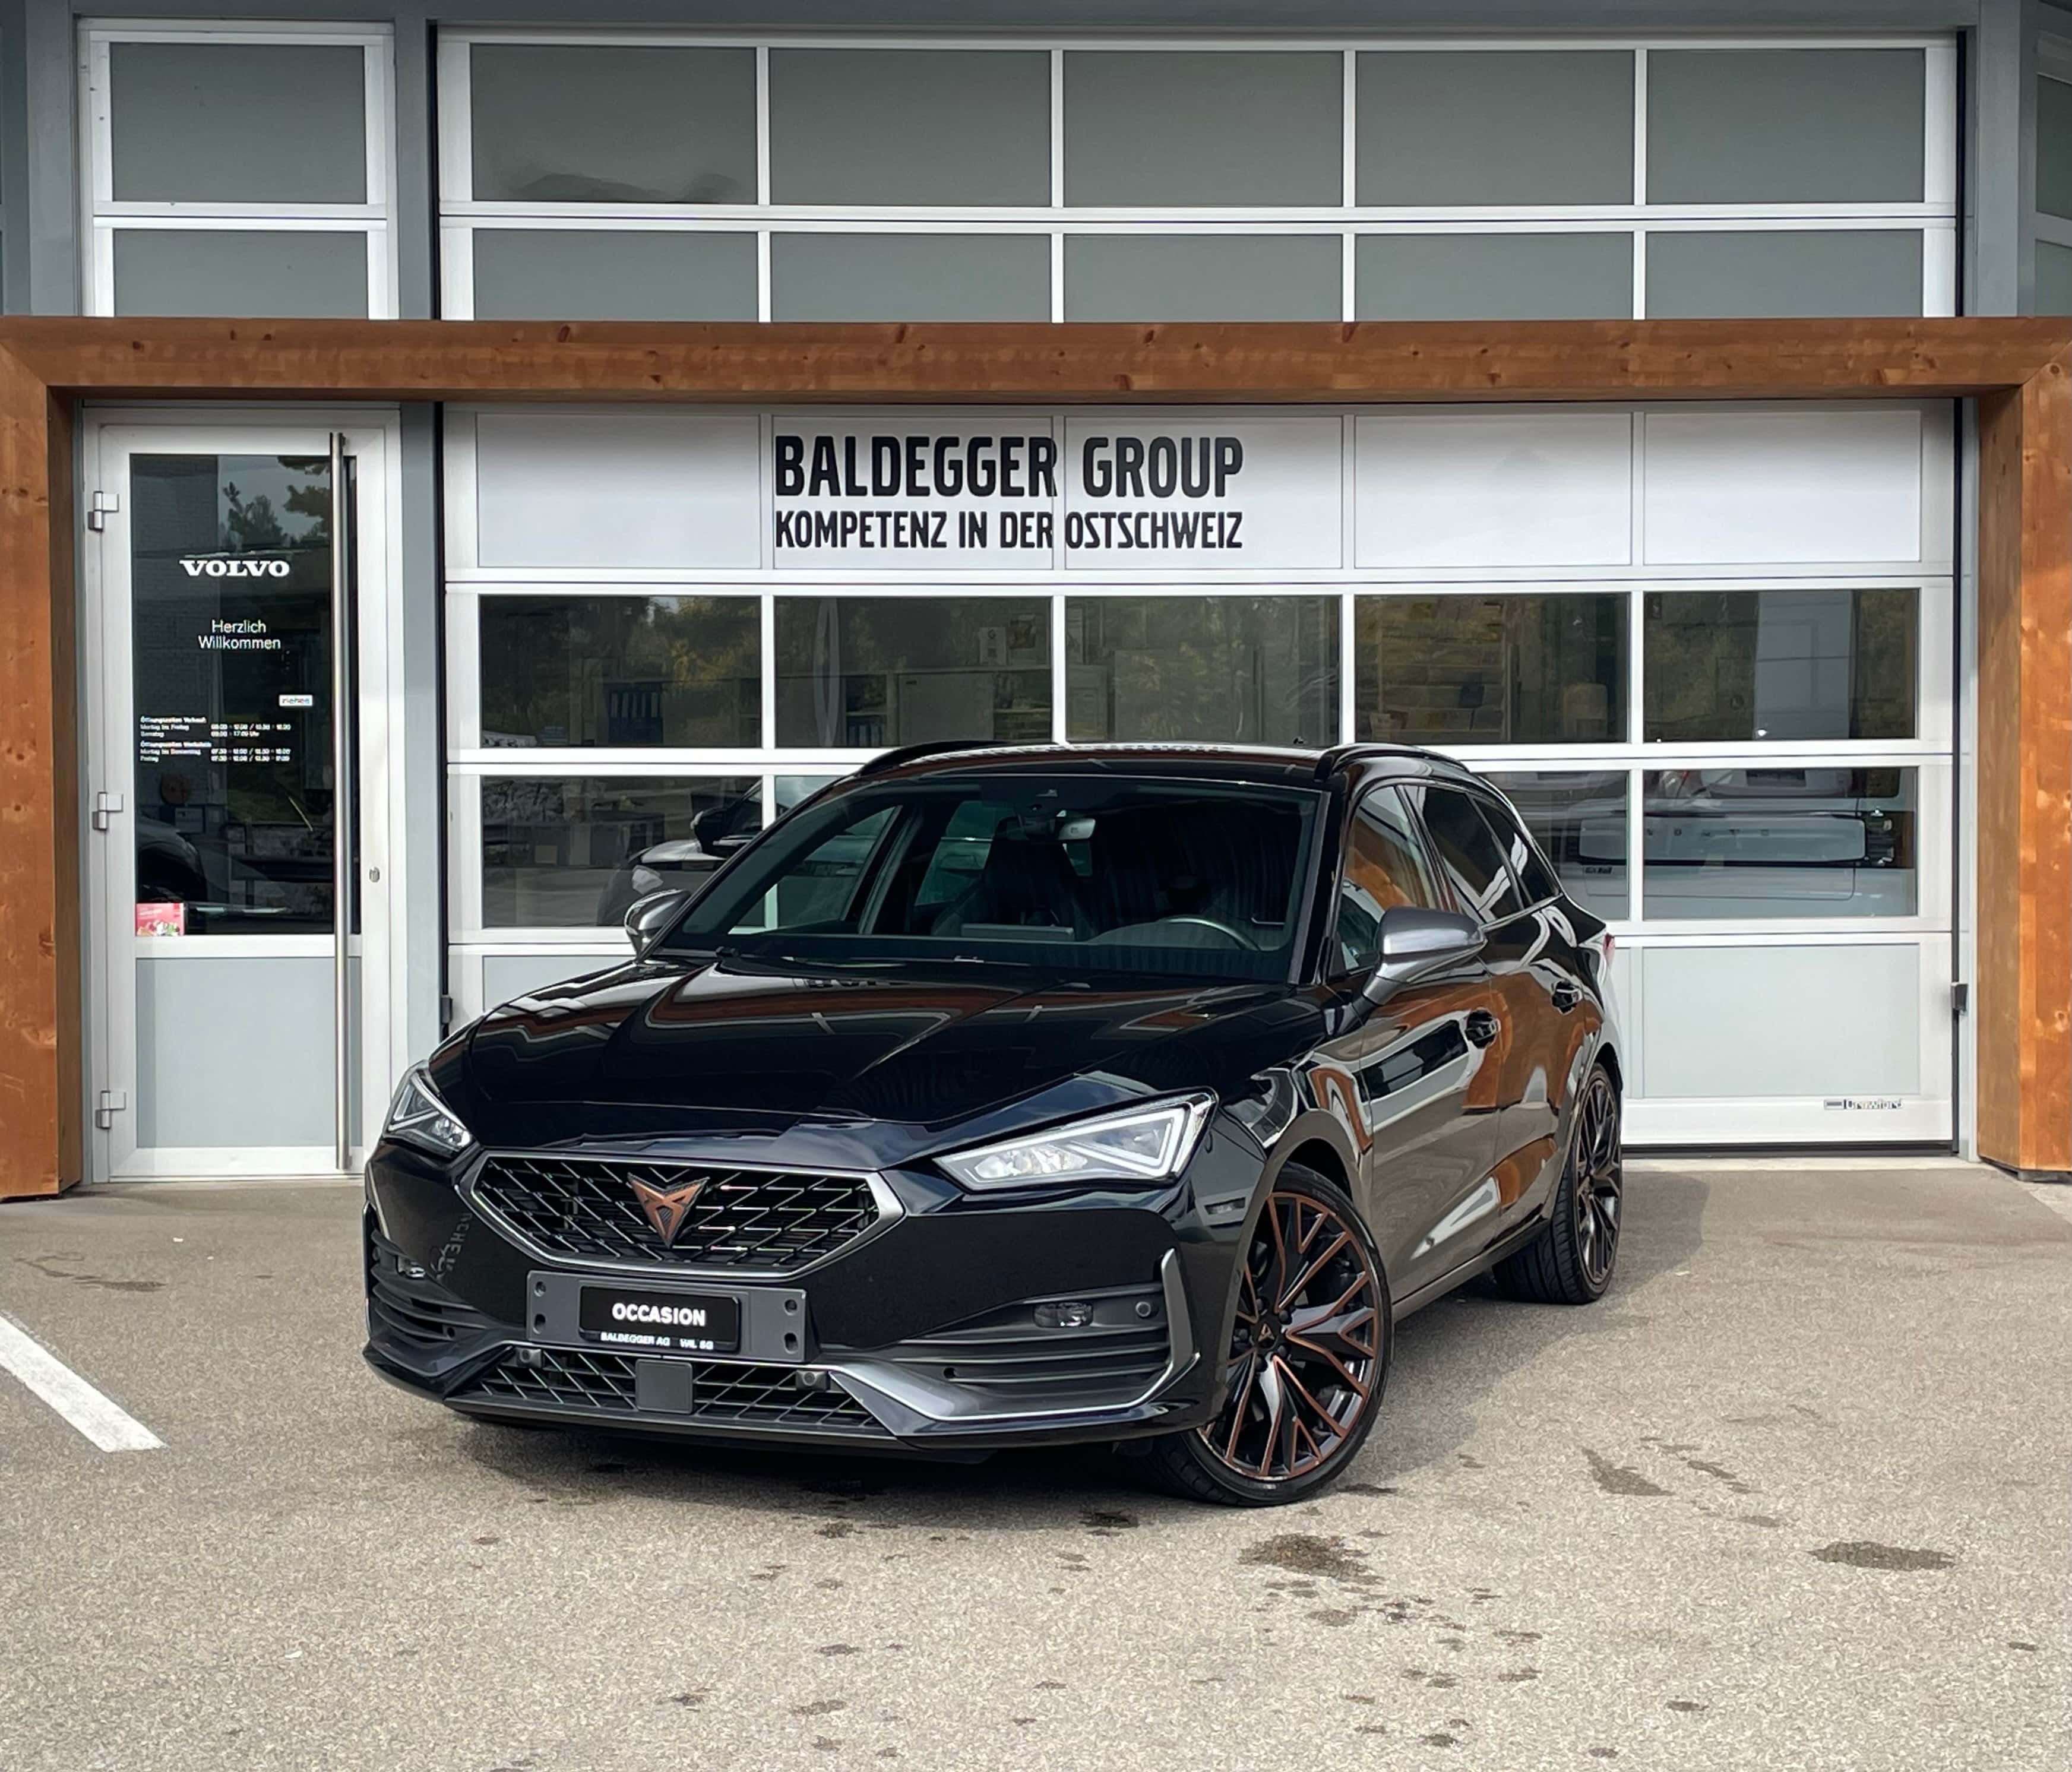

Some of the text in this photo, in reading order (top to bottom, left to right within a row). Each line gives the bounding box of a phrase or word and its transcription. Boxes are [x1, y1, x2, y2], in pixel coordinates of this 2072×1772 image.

[775, 436, 1244, 498] BALDEGGER GROUP
[776, 511, 1243, 549] KOMPETENZ IN DER OSTSCHWEIZ
[179, 560, 290, 577] VOLVO
[211, 619, 266, 634] Herzlich
[198, 635, 281, 650] Willkommen
[612, 1302, 706, 1327] OCCASION
[600, 1331, 655, 1345] BALDEGGER
[656, 1336, 671, 1346] AG
